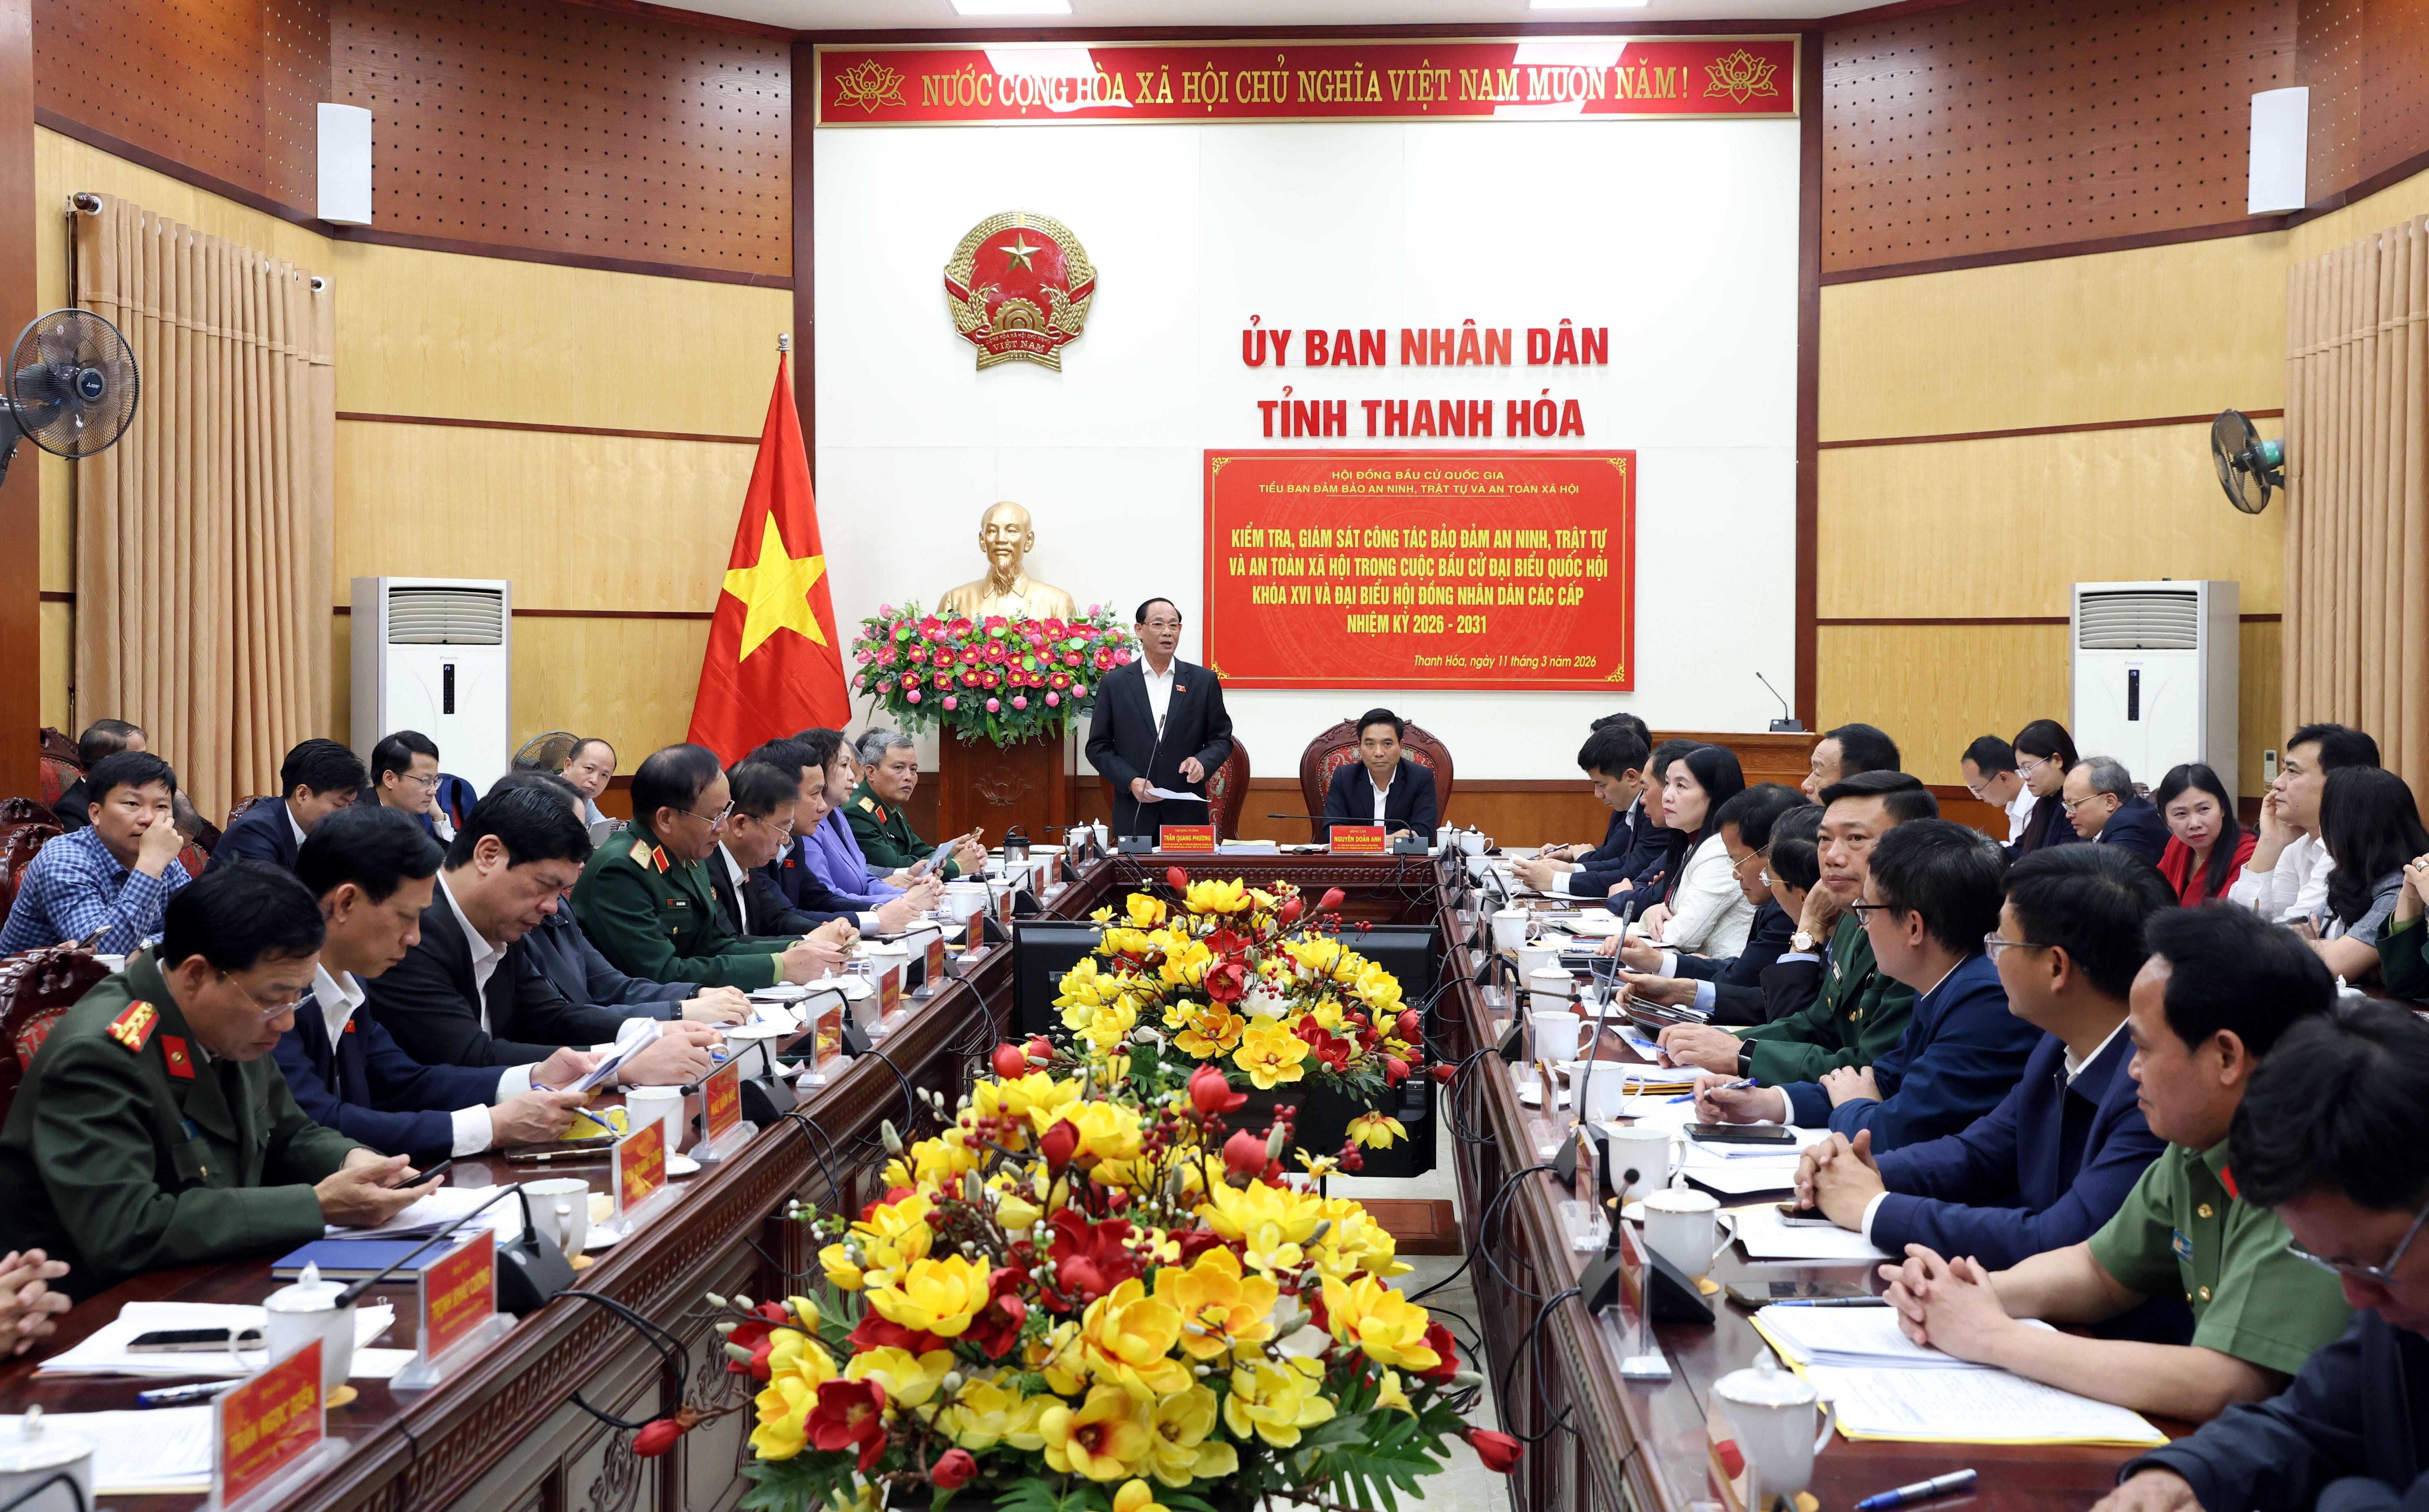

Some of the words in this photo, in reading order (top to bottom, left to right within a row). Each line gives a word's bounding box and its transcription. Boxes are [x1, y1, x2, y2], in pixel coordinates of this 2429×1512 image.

[922, 63, 992, 107] NƯỚC
[1075, 61, 1128, 104] HÒA
[1136, 65, 1174, 104] XÃ
[1182, 62, 1228, 112] HỘI
[1236, 54, 1289, 104] CHỦ
[1297, 62, 1382, 103] NGHĨA
[1388, 59, 1451, 110] VIỆT
[1459, 67, 1521, 102] NAM
[986, 336, 999, 344] CỘNG
[992, 339, 1017, 350] VIỆT
[1020, 340, 1045, 353] NAM
[1243, 314, 1291, 367] ỦY
[1306, 329, 1386, 366] BAN
[1401, 319, 1511, 365] NHÂN
[1527, 318, 1608, 365] DÂN
[1258, 385, 1346, 437] TỈNH
[1361, 399, 1492, 437] THANH
[1507, 389, 1585, 437] HÓA
[1259, 480, 1284, 493] TIỂU
[1287, 484, 1310, 493] BAN
[1313, 482, 1338, 493] ĐẢM
[1342, 482, 1366, 493] BẢO
[1368, 485, 1383, 493] AN
[1387, 485, 1417, 495] NINH,
[1420, 483, 1450, 495] TRẬT
[1453, 484, 1468, 495] TỰ
[1470, 483, 1486, 493] VÀ
[1489, 485, 1504, 493] AN
[1507, 483, 1538, 493] TOÀN
[1542, 483, 1557, 493] XÃ
[1560, 483, 1579, 495] HỘI
[1332, 469, 1353, 481] HỘI
[1356, 468, 1391, 480] ĐỒNG
[1395, 468, 1420, 480] BẦU
[1424, 468, 1442, 480] CỬ
[1444, 468, 1480, 480] QUỐC
[1483, 471, 1504, 480] GIA
[1232, 521, 1264, 548] KIỂM
[1268, 529, 1295, 550] TRA,
[1299, 525, 1332, 548] GIÁM
[1336, 525, 1361, 548] SÁT
[1364, 525, 1399, 548] CÔNG
[1402, 525, 1427, 548] TÁC
[1431, 523, 1457, 548] BẢO
[1460, 523, 1490, 548] ĐẢM
[1493, 529, 1512, 548] AN
[1515, 529, 1551, 551] NINH,
[1555, 526, 1587, 552] TRẬT
[1590, 528, 1608, 553] TỰ
[1229, 553, 1246, 576] VÀ
[1249, 557, 1267, 576] AN
[1271, 553, 1304, 576] TOÀN
[1308, 554, 1326, 576] XÃ
[1329, 554, 1351, 580] HỘI
[1354, 557, 1396, 577] TRONG
[1400, 554, 1435, 581] CUỘC
[1438, 551, 1464, 577] BẦU
[1468, 552, 1487, 577] CỬ
[1489, 558, 1510, 581] ĐẠI
[1514, 550, 1544, 577] BIỂU
[1548, 551, 1582, 579] QUỐC
[1586, 554, 1608, 582] HỘI
[1253, 582, 1287, 604] KHÓA
[1290, 586, 1311, 604] XVI
[1314, 582, 1331, 604] VÀ
[1334, 586, 1356, 609] ĐẠI
[1360, 578, 1389, 605] BIỂU
[1393, 582, 1414, 609] HỘI
[1418, 580, 1454, 605] ĐỒNG
[1457, 582, 1494, 605] NHÂN
[1497, 582, 1524, 605] DÂN
[1528, 582, 1554, 606] CÁC
[1558, 580, 1584, 606] CẤP
[1347, 610, 1389, 637] NHIỆM
[1393, 610, 1410, 633] KỲ
[1413, 615, 1444, 634] 2026
[1457, 615, 1486, 634] 2031
[1414, 655, 1443, 667] Thanh
[1445, 654, 1467, 668] Hóa,
[1470, 654, 1495, 670] ngày
[1499, 655, 1508, 667] 11
[1510, 654, 1539, 670] tháng
[1541, 655, 1547, 667] 3
[1549, 655, 1572, 667] năm
[1574, 656, 1596, 668] 2026
